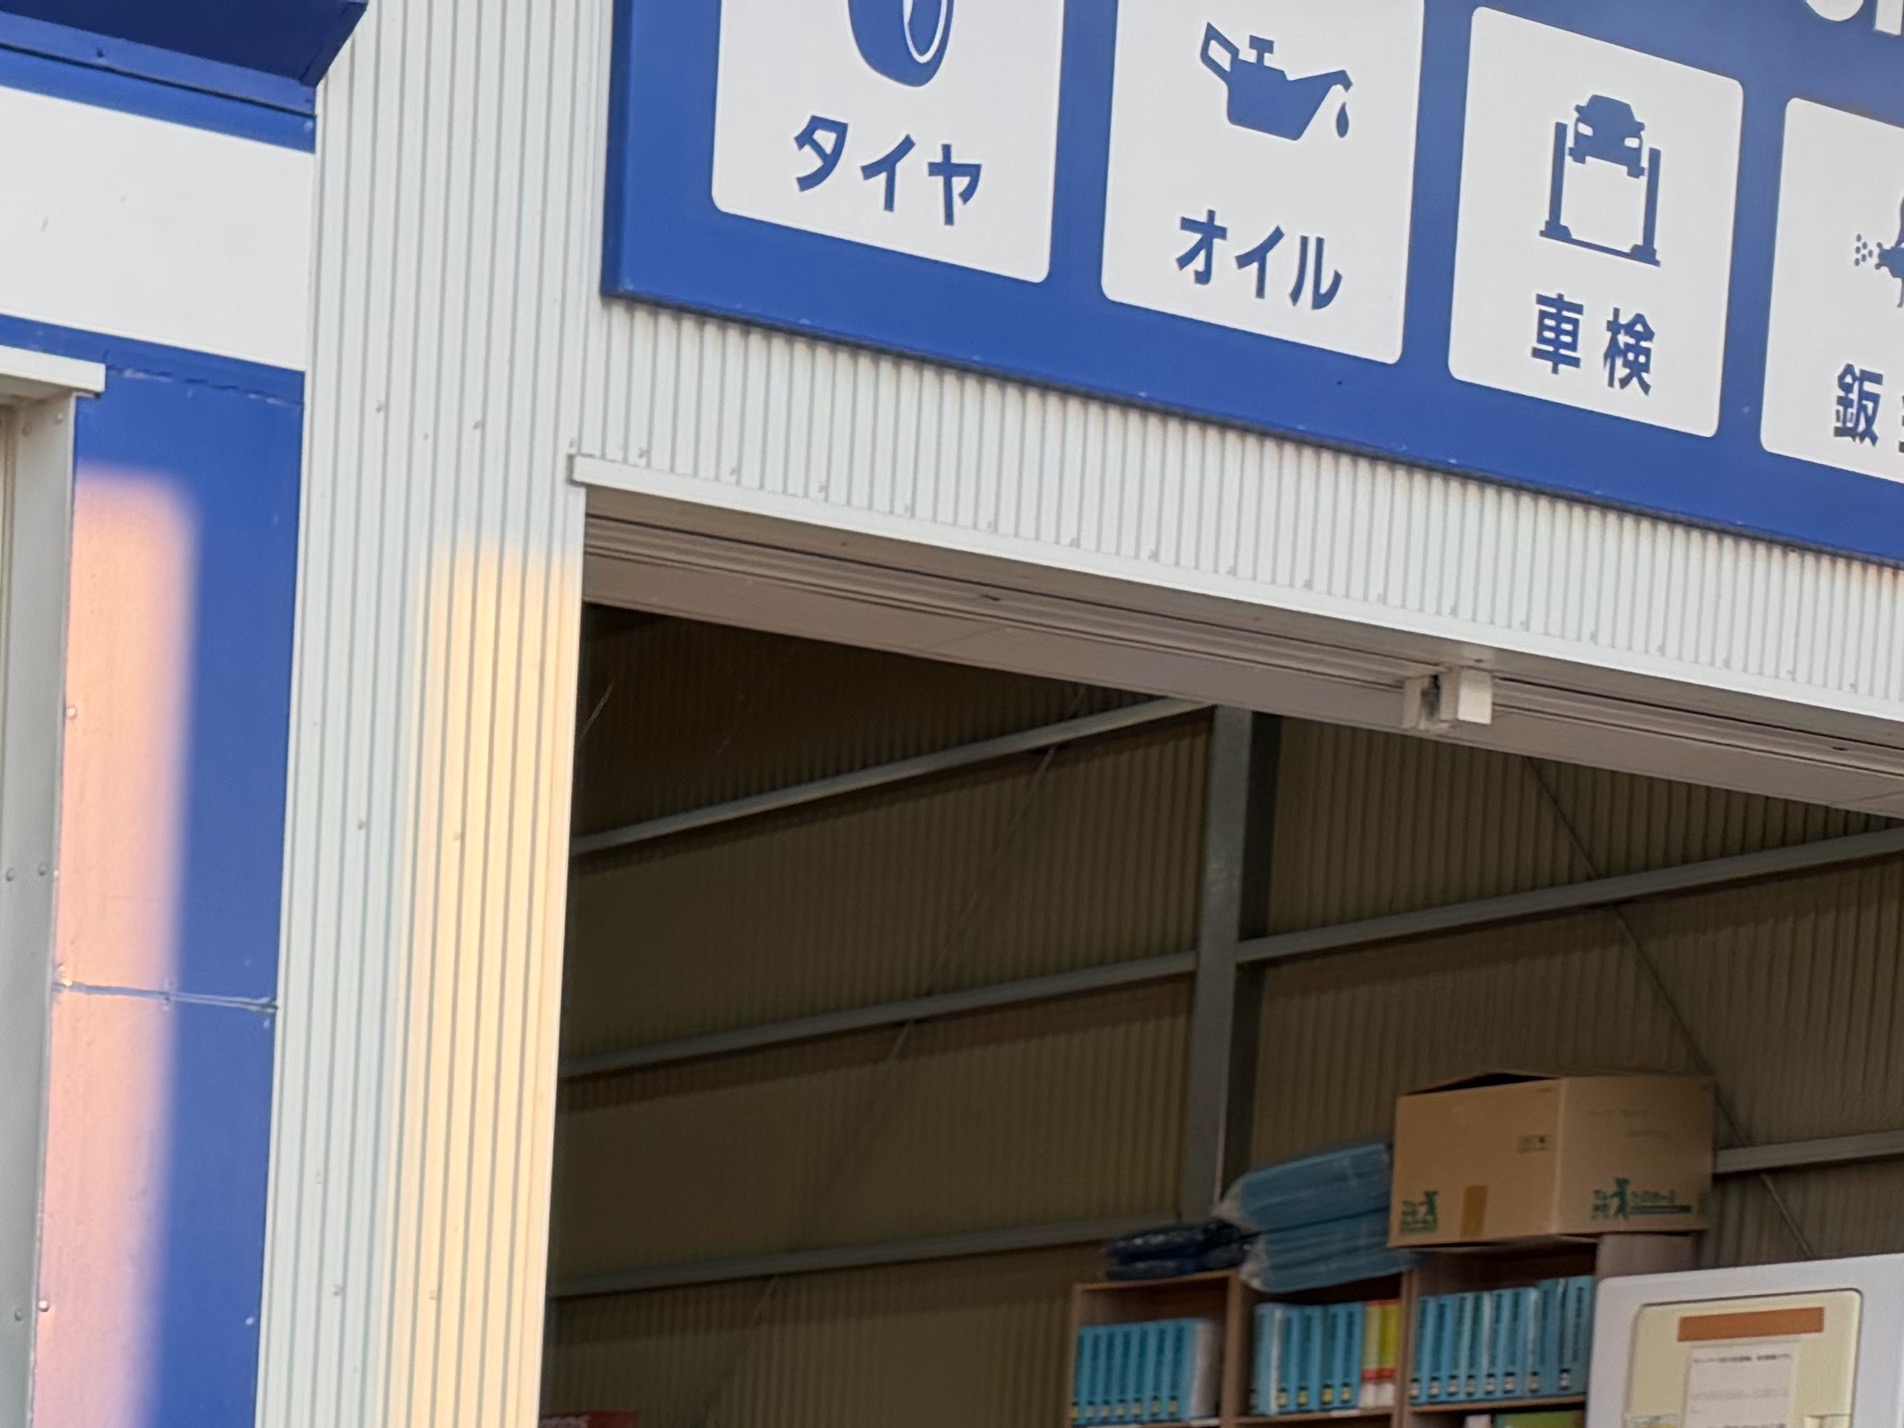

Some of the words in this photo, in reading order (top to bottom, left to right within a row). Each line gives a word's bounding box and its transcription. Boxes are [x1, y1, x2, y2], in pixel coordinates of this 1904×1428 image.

[794, 115, 982, 226] タイヤ
[1175, 209, 1343, 310] オイル
[1531, 293, 1656, 396] 車検
[1833, 363, 1904, 454] 鈑
